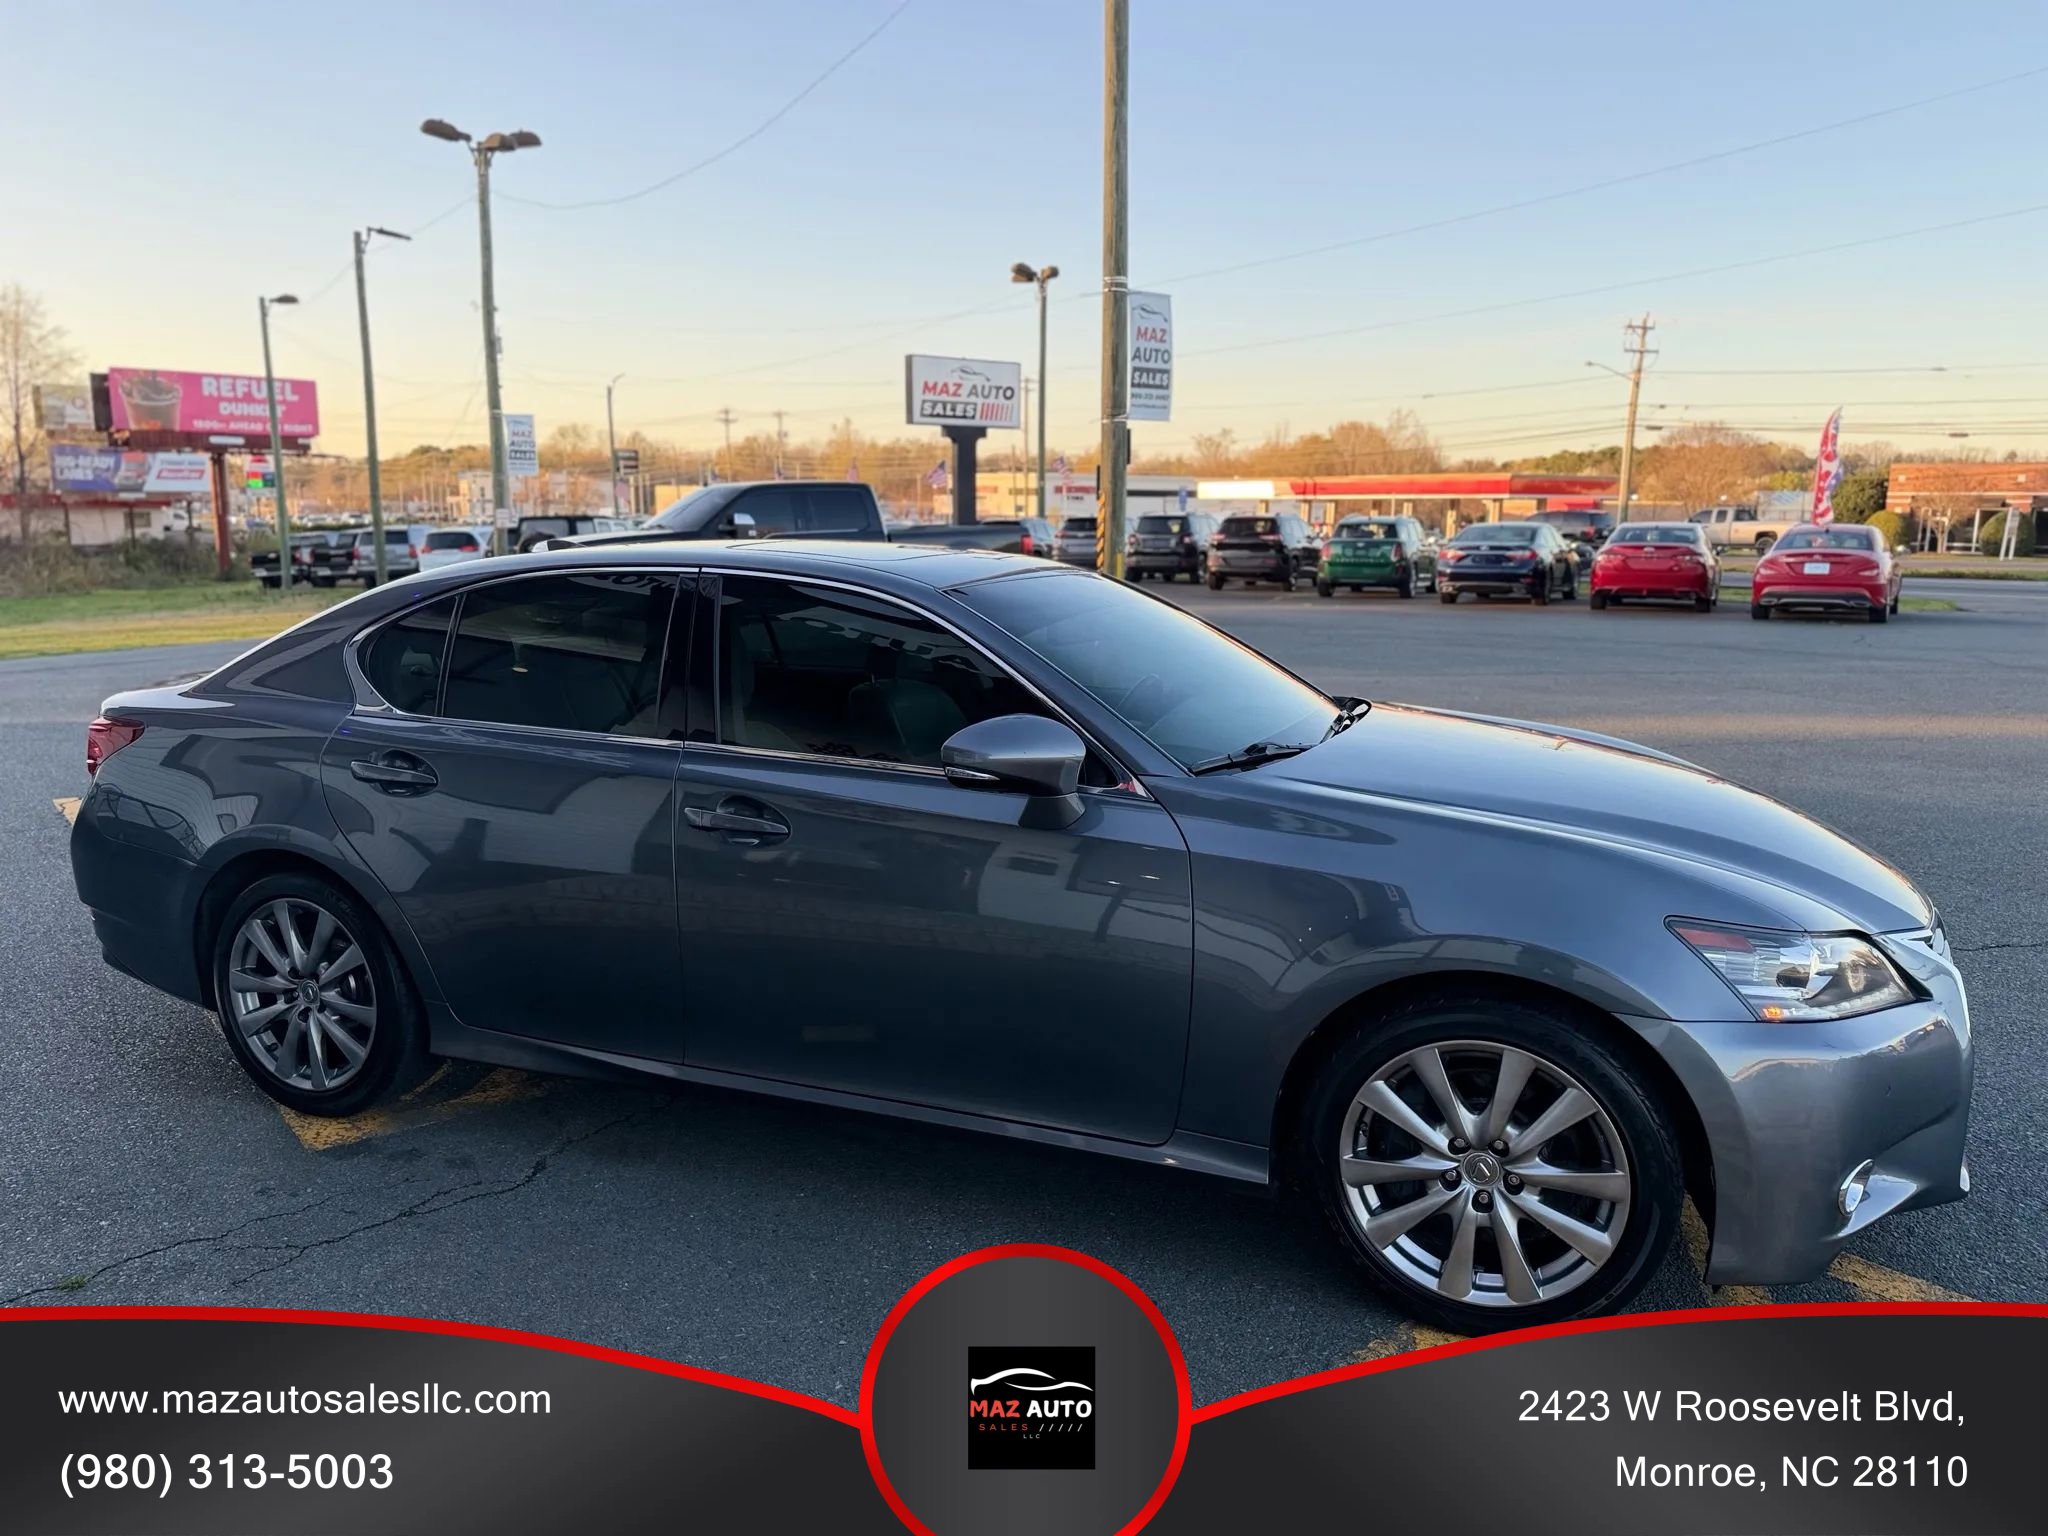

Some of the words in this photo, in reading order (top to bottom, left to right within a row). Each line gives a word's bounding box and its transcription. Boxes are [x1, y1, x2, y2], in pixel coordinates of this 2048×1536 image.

[1136, 326, 1167, 343] MAZ
[1131, 347, 1171, 364] AUTO
[1132, 370, 1170, 387] SALES
[202, 376, 299, 401] REFUEL
[922, 381, 962, 397] MAZ
[966, 384, 1015, 400] AUTO
[922, 401, 976, 418] SALES
[512, 429, 533, 438] MAZ
[509, 440, 535, 449] AUTO
